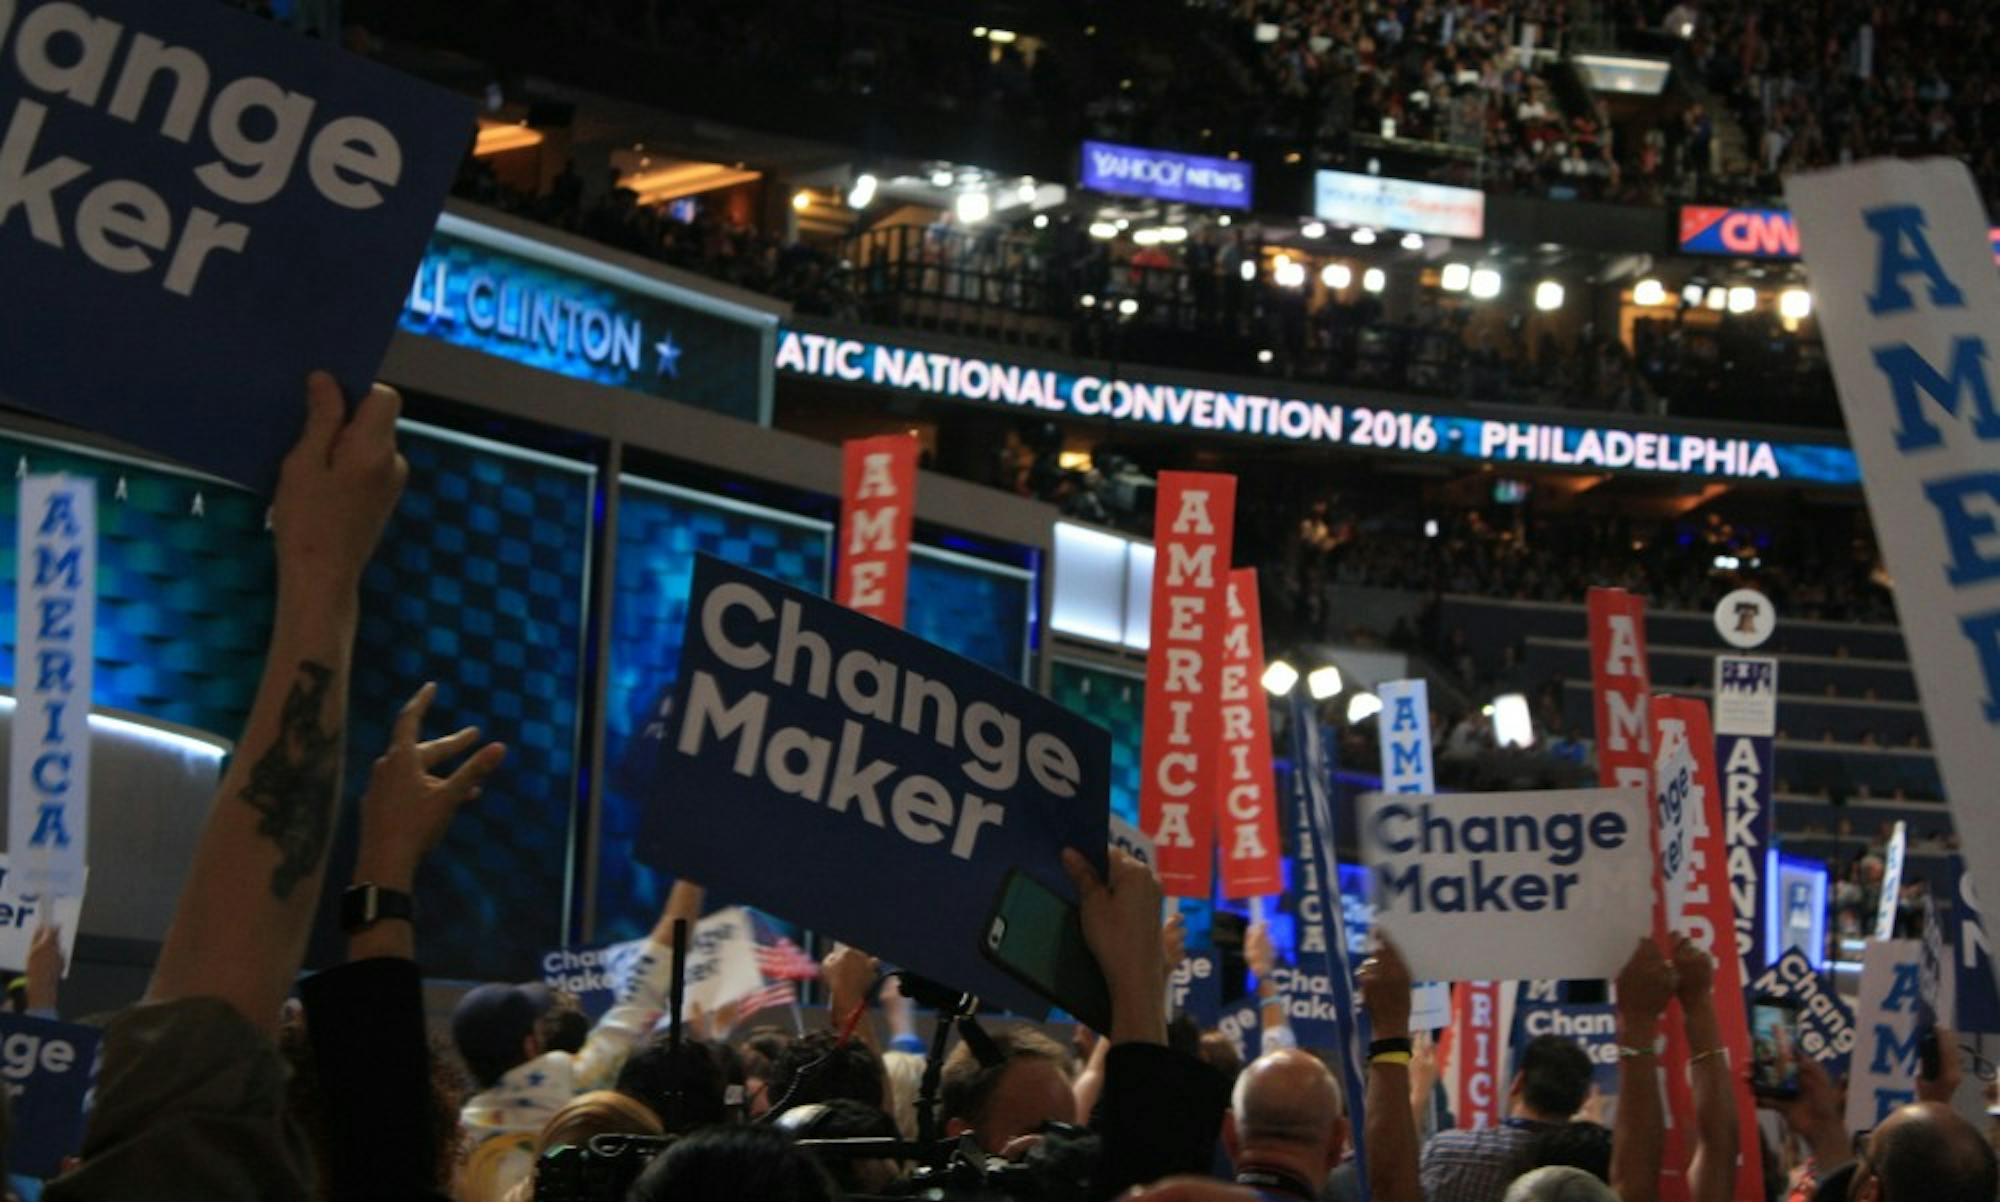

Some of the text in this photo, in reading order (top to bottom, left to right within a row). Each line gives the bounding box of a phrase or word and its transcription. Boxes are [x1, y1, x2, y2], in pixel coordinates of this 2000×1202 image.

[0, 0, 401, 209] ange
[1186, 168, 1245, 193] NEWS
[403, 260, 641, 371] LL CLINTON
[776, 331, 1780, 479] ATIC NATIONAL CONVENTION 2016 PHILADELPHIA
[27, 492, 81, 849] AMERICA
[702, 581, 1081, 799] Change
[1155, 489, 1217, 850] AMERICA
[676, 670, 1005, 861] Maker
[1370, 800, 1628, 867] Change
[1378, 859, 1581, 914] Maker
